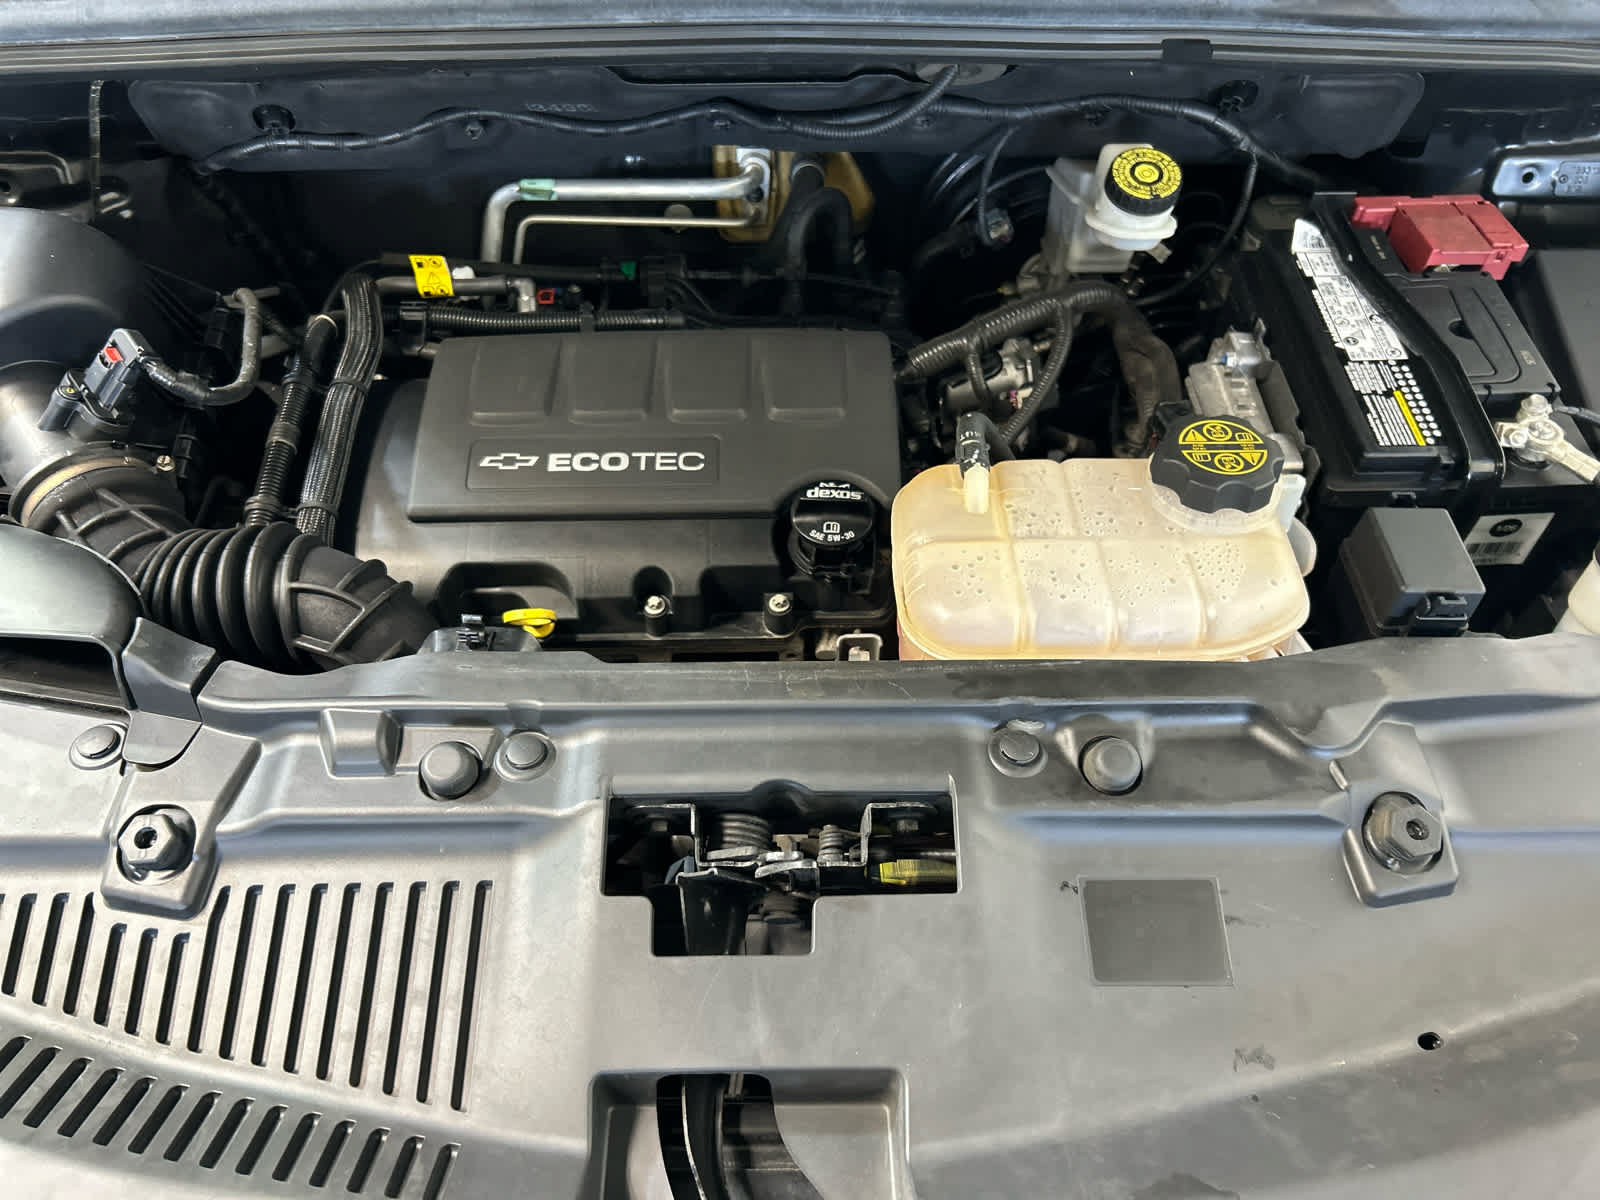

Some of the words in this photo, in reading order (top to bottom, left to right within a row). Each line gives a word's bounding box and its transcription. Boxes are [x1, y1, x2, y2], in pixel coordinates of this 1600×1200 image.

[547, 452, 705, 472] ECOTEC
[806, 486, 864, 500] dexos
[809, 529, 825, 541] SAE
[827, 530, 855, 542] 5W-30
